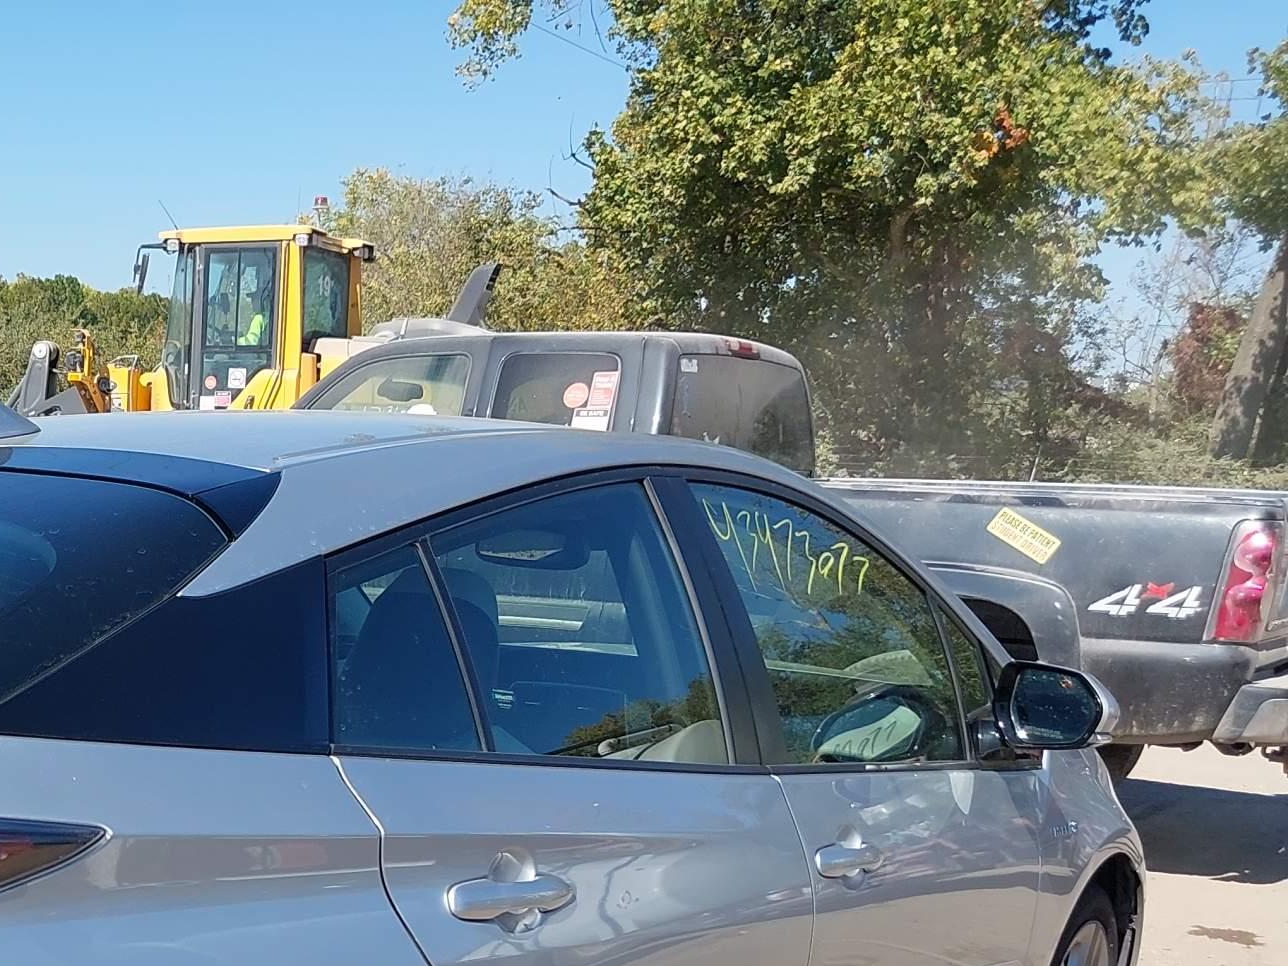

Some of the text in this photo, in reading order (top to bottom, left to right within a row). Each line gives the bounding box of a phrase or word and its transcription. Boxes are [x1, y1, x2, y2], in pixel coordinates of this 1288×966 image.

[998, 511, 1056, 550] PLEASE BE PATIENT
